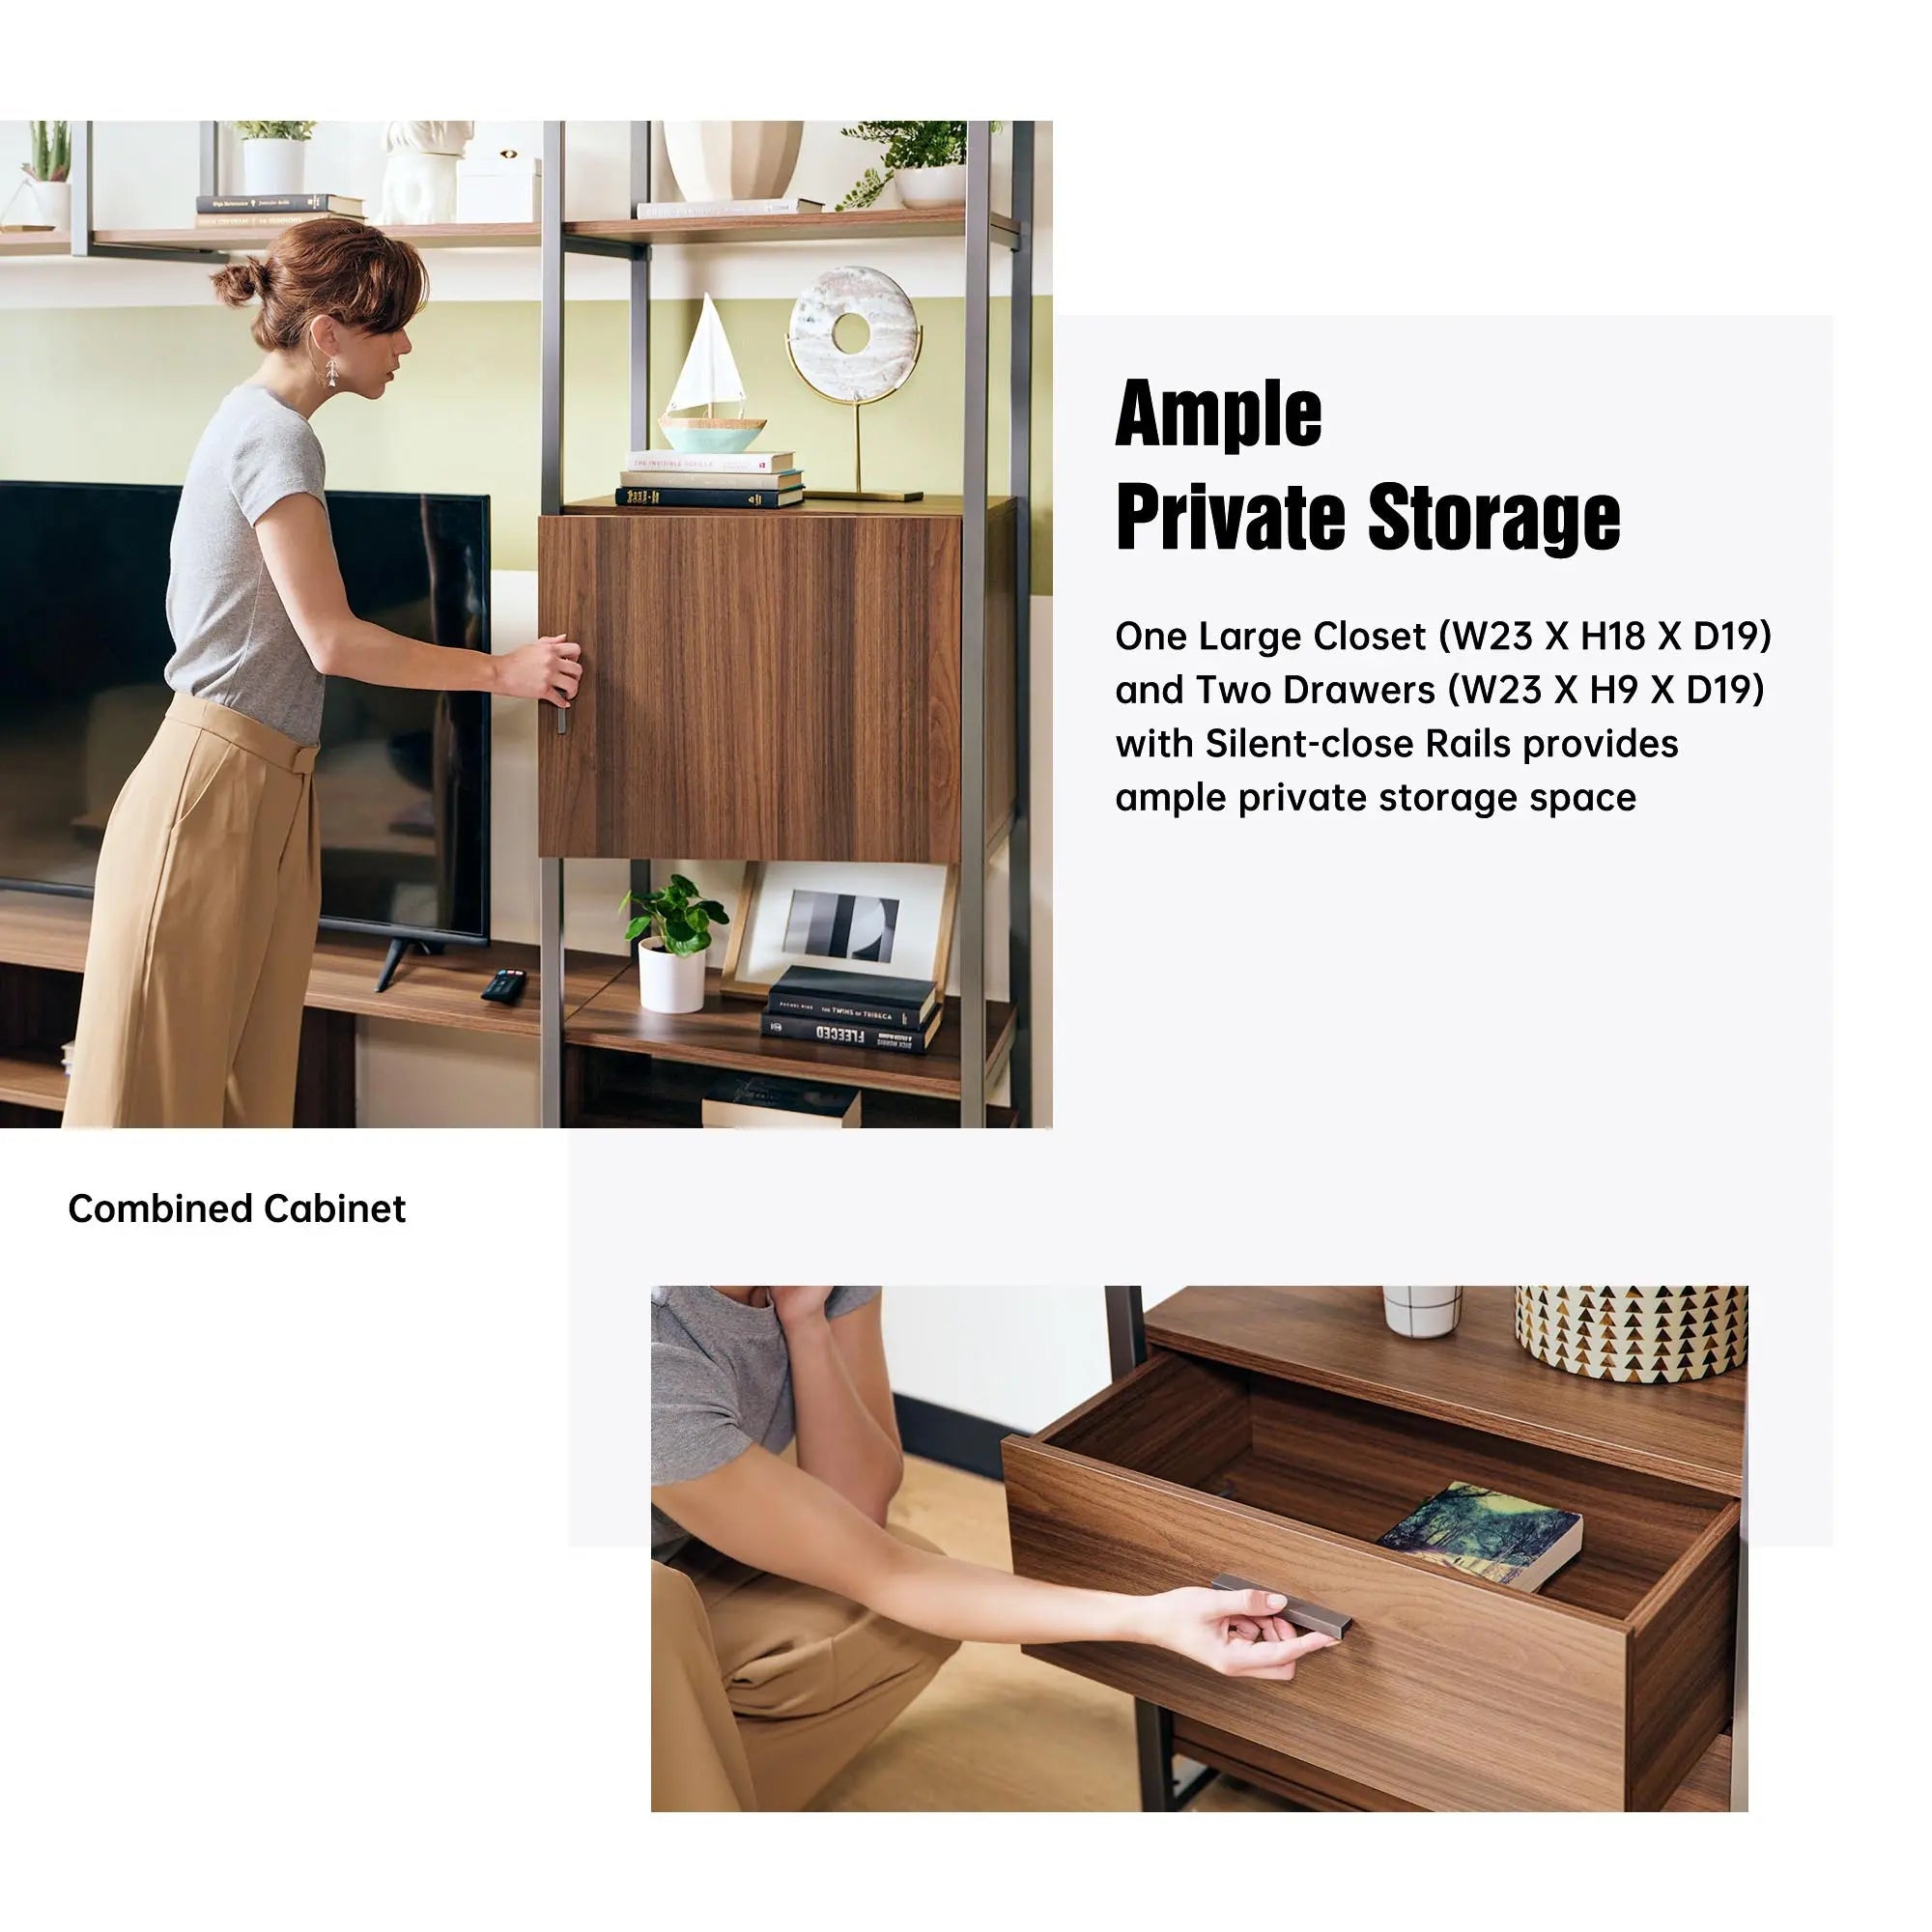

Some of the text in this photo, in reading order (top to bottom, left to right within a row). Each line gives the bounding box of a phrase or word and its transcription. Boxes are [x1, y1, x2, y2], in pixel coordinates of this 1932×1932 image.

[832, 1007, 854, 1016] TWINS
[863, 1010, 893, 1020] TRIBECA
[816, 1025, 866, 1044] FLEECED
